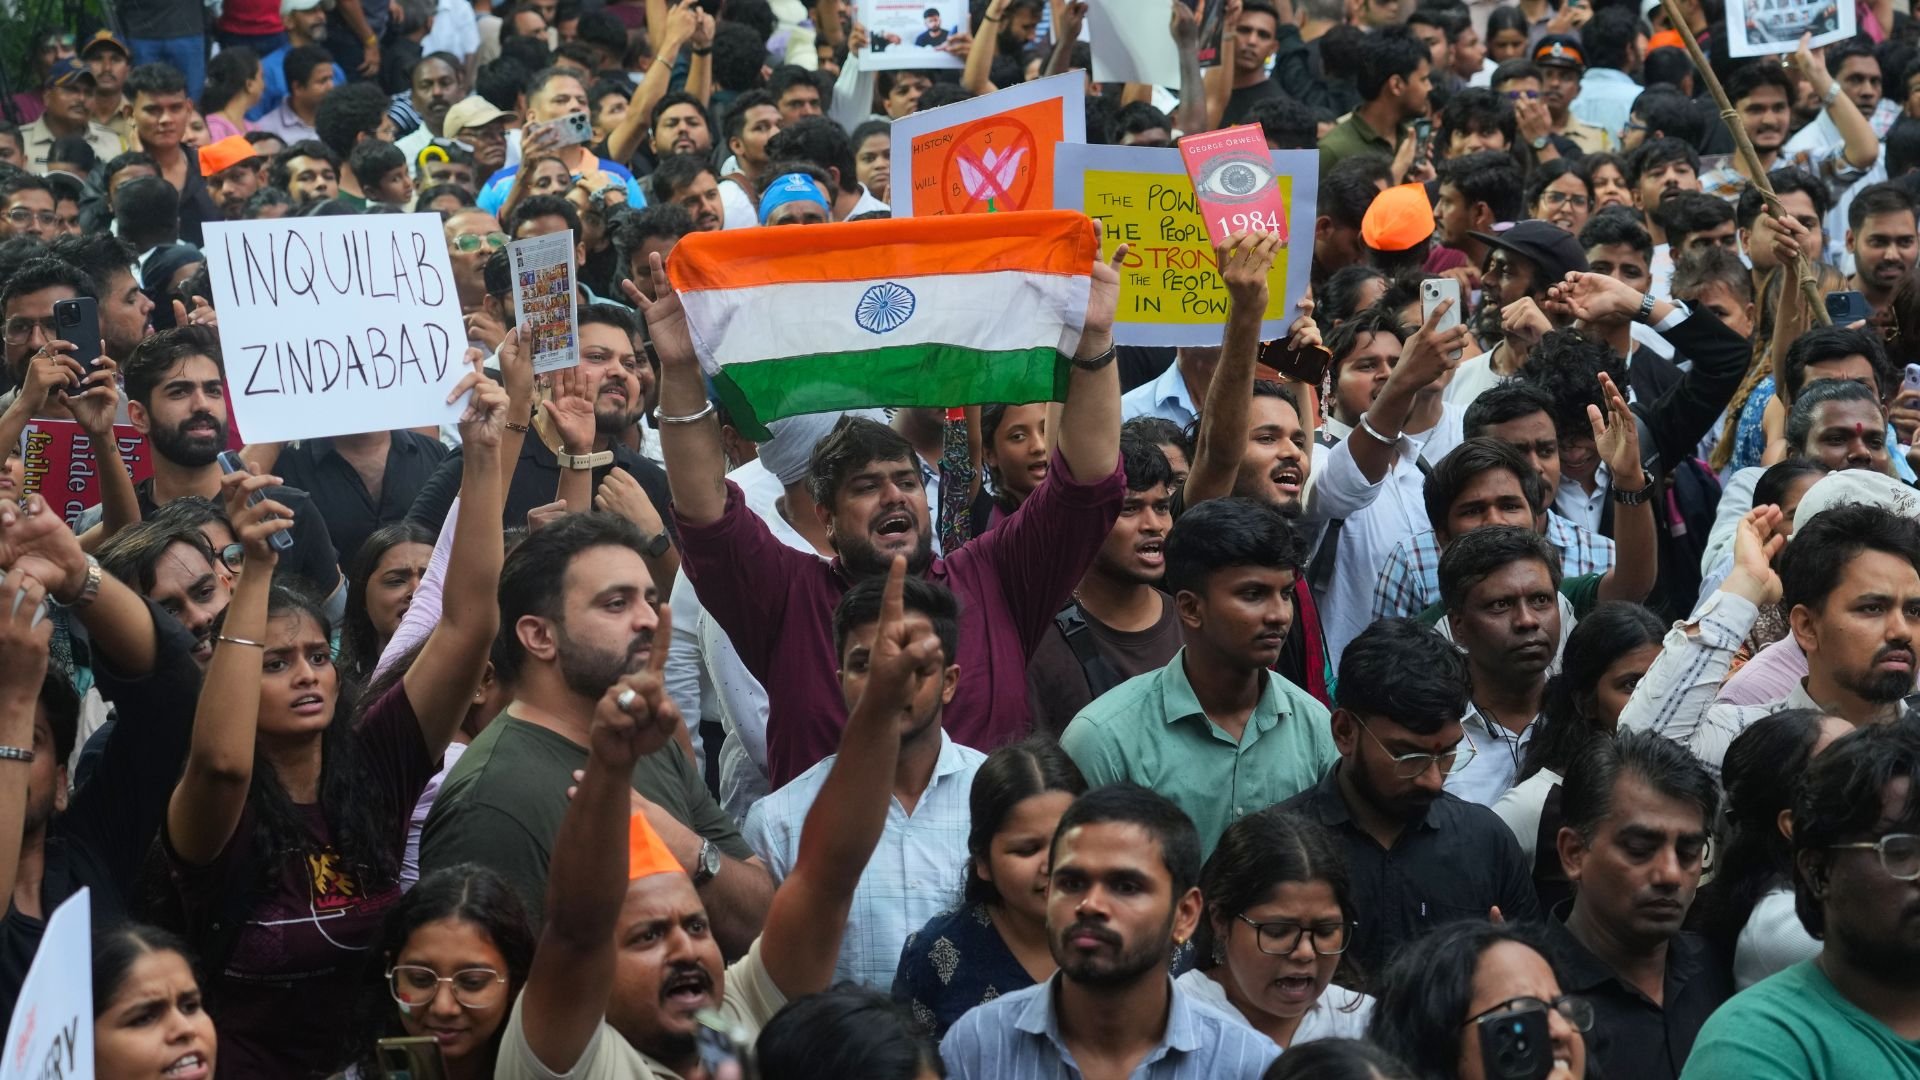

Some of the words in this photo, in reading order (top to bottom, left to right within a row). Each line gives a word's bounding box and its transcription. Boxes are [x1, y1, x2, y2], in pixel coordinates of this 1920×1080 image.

[913, 133, 954, 154] HISTORY
[984, 132, 993, 144] J
[1189, 142, 1224, 154] GEORGE
[1226, 135, 1262, 147] ORWELL
[1021, 166, 1028, 176] P
[914, 176, 937, 191] WILL
[952, 183, 961, 196] B
[1097, 193, 1134, 208] THE
[1160, 215, 1209, 242] PEOPL
[1217, 209, 1281, 238] 1984
[1122, 243, 1219, 269] STRON
[224, 229, 444, 307] INQUILAB
[1128, 273, 1151, 286] THE
[1162, 269, 1224, 291] PEOPL
[1135, 295, 1161, 313] IN
[1182, 291, 1228, 315] POW
[240, 323, 450, 396] ZINDABAD
